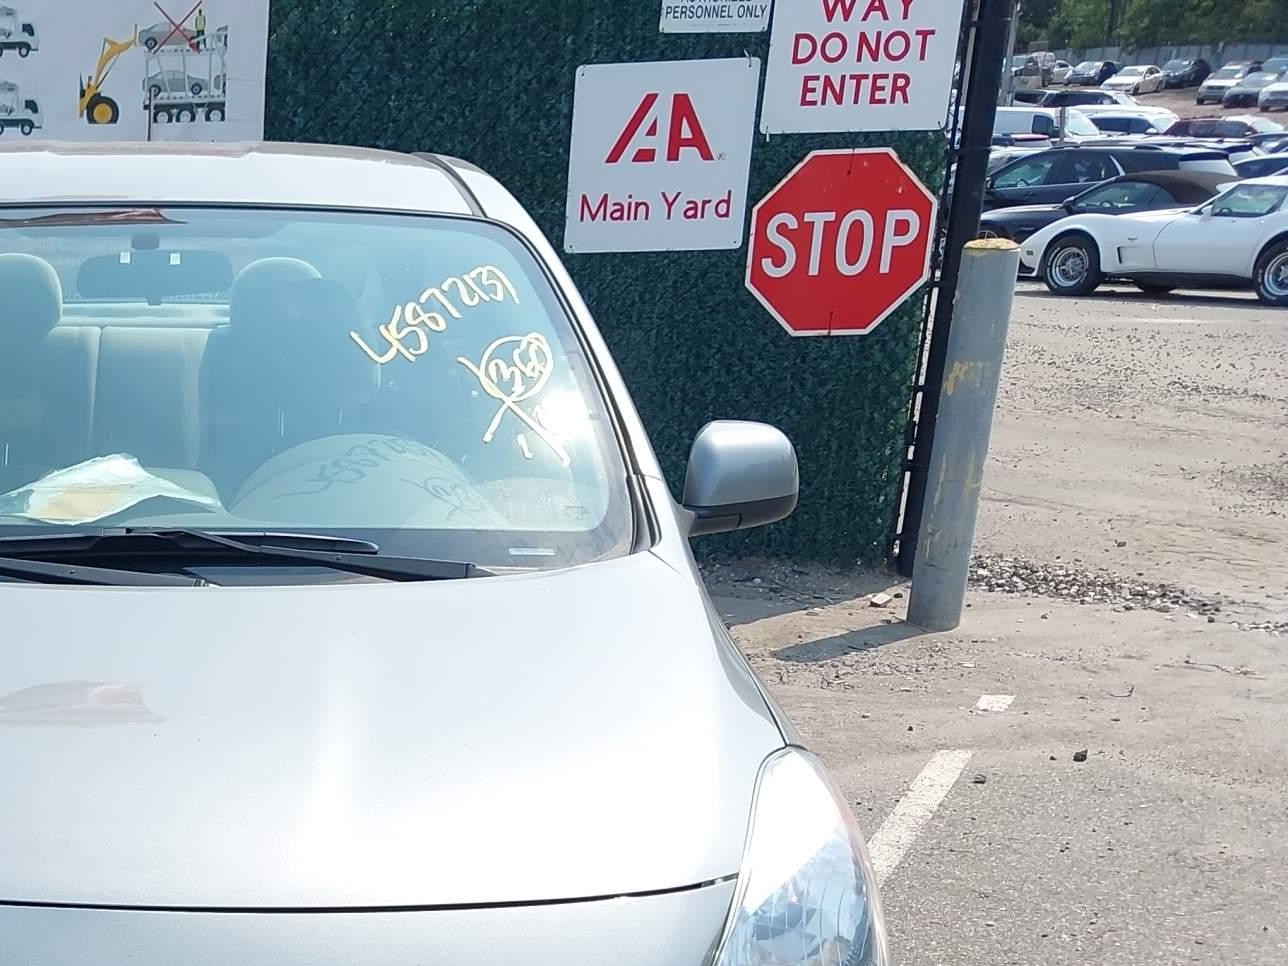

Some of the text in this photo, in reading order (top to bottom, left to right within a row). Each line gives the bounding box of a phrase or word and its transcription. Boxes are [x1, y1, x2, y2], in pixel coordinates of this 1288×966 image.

[665, 4, 768, 19] PERSONNEL ONLY
[822, 0, 915, 23] WAY
[791, 29, 936, 65] DO NOT
[799, 73, 911, 107] ENTER
[579, 190, 732, 223] Main Yard
[761, 209, 921, 279] STOP
